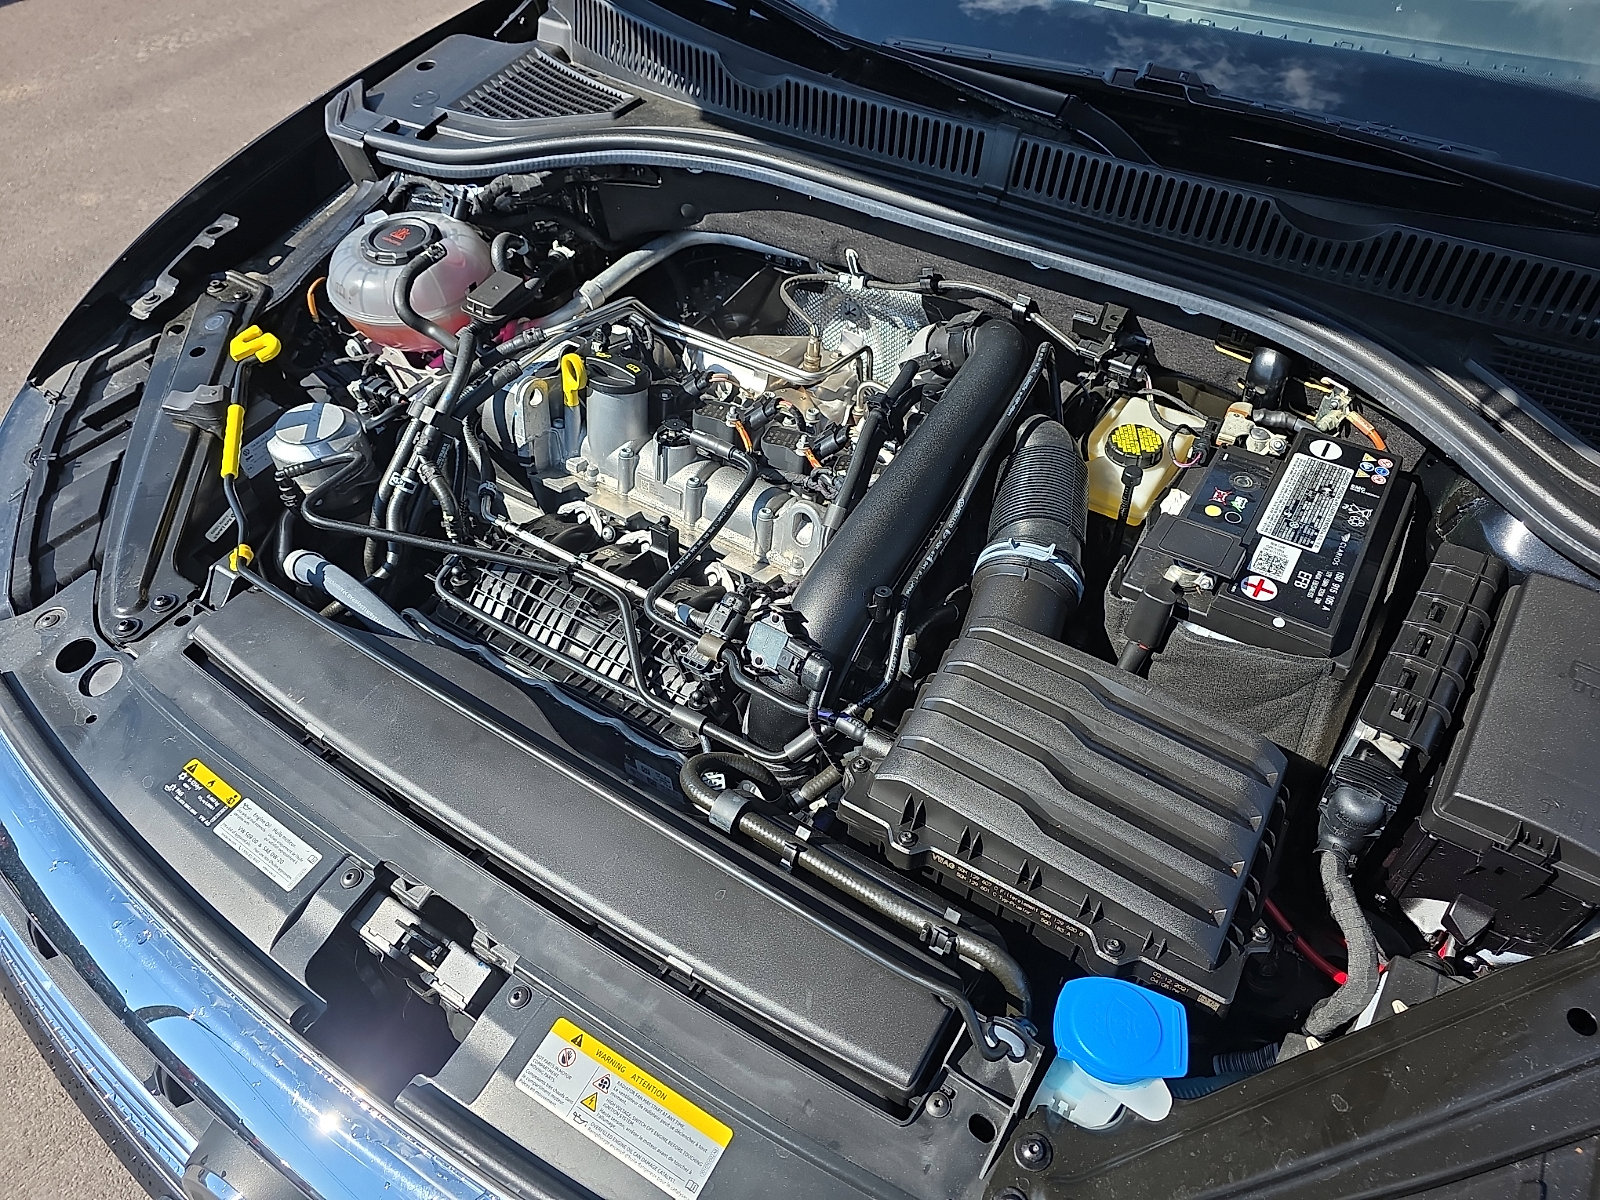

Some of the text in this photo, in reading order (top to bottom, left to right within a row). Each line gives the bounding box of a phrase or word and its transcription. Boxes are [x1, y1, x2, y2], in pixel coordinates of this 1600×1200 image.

[1330, 540, 1346, 566] CLARIOS
[1292, 570, 1313, 589] EFB
[1328, 582, 1341, 594] 915
[1323, 594, 1336, 605] 105
[251, 811, 272, 829] Engine Oil
[236, 825, 246, 834] VW
[261, 845, 272, 854] SAE
[269, 851, 285, 864] 0W-20
[271, 826, 297, 848] Huile moteur
[968, 878, 979, 887] 129
[969, 872, 980, 882] 129
[529, 1062, 555, 1082] MOVING PARTS
[535, 1053, 544, 1061] HOT
[542, 1058, 555, 1068] PARTS
[558, 1068, 572, 1080] MOTOR
[594, 1048, 668, 1101] WARNING ATTENTION
[602, 1102, 620, 1116] IGNITION
[616, 1080, 635, 1095] RADIATOR
[634, 1092, 643, 1101] FAN
[642, 1097, 651, 1106] MAY
[650, 1103, 663, 1113] START
[666, 1113, 676, 1122] ANY
[605, 1097, 616, 1107] HIGH
[631, 1115, 646, 1128] SWITCH
[645, 1125, 654, 1133] OFF
[653, 1130, 668, 1143] ENGINE
[667, 1140, 683, 1153] BEFORE
[682, 1150, 703, 1166] TOUCHING
[617, 1089, 639, 1106] ventilateur
[642, 1106, 661, 1121] radiateur
[659, 1117, 670, 1127] peut
[697, 1143, 708, 1153] tout
[589, 1121, 613, 1140] OVERFILLED
[611, 1136, 627, 1149] ENGINE
[625, 1146, 634, 1154] OIL
[632, 1151, 642, 1160] CAN
[640, 1156, 658, 1171] DAMAGE
[598, 1107, 612, 1119] Haute
[642, 1137, 658, 1150] moteur
[656, 1147, 669, 1158] avant
[667, 1154, 674, 1162] de
[673, 1158, 690, 1172] toucher
